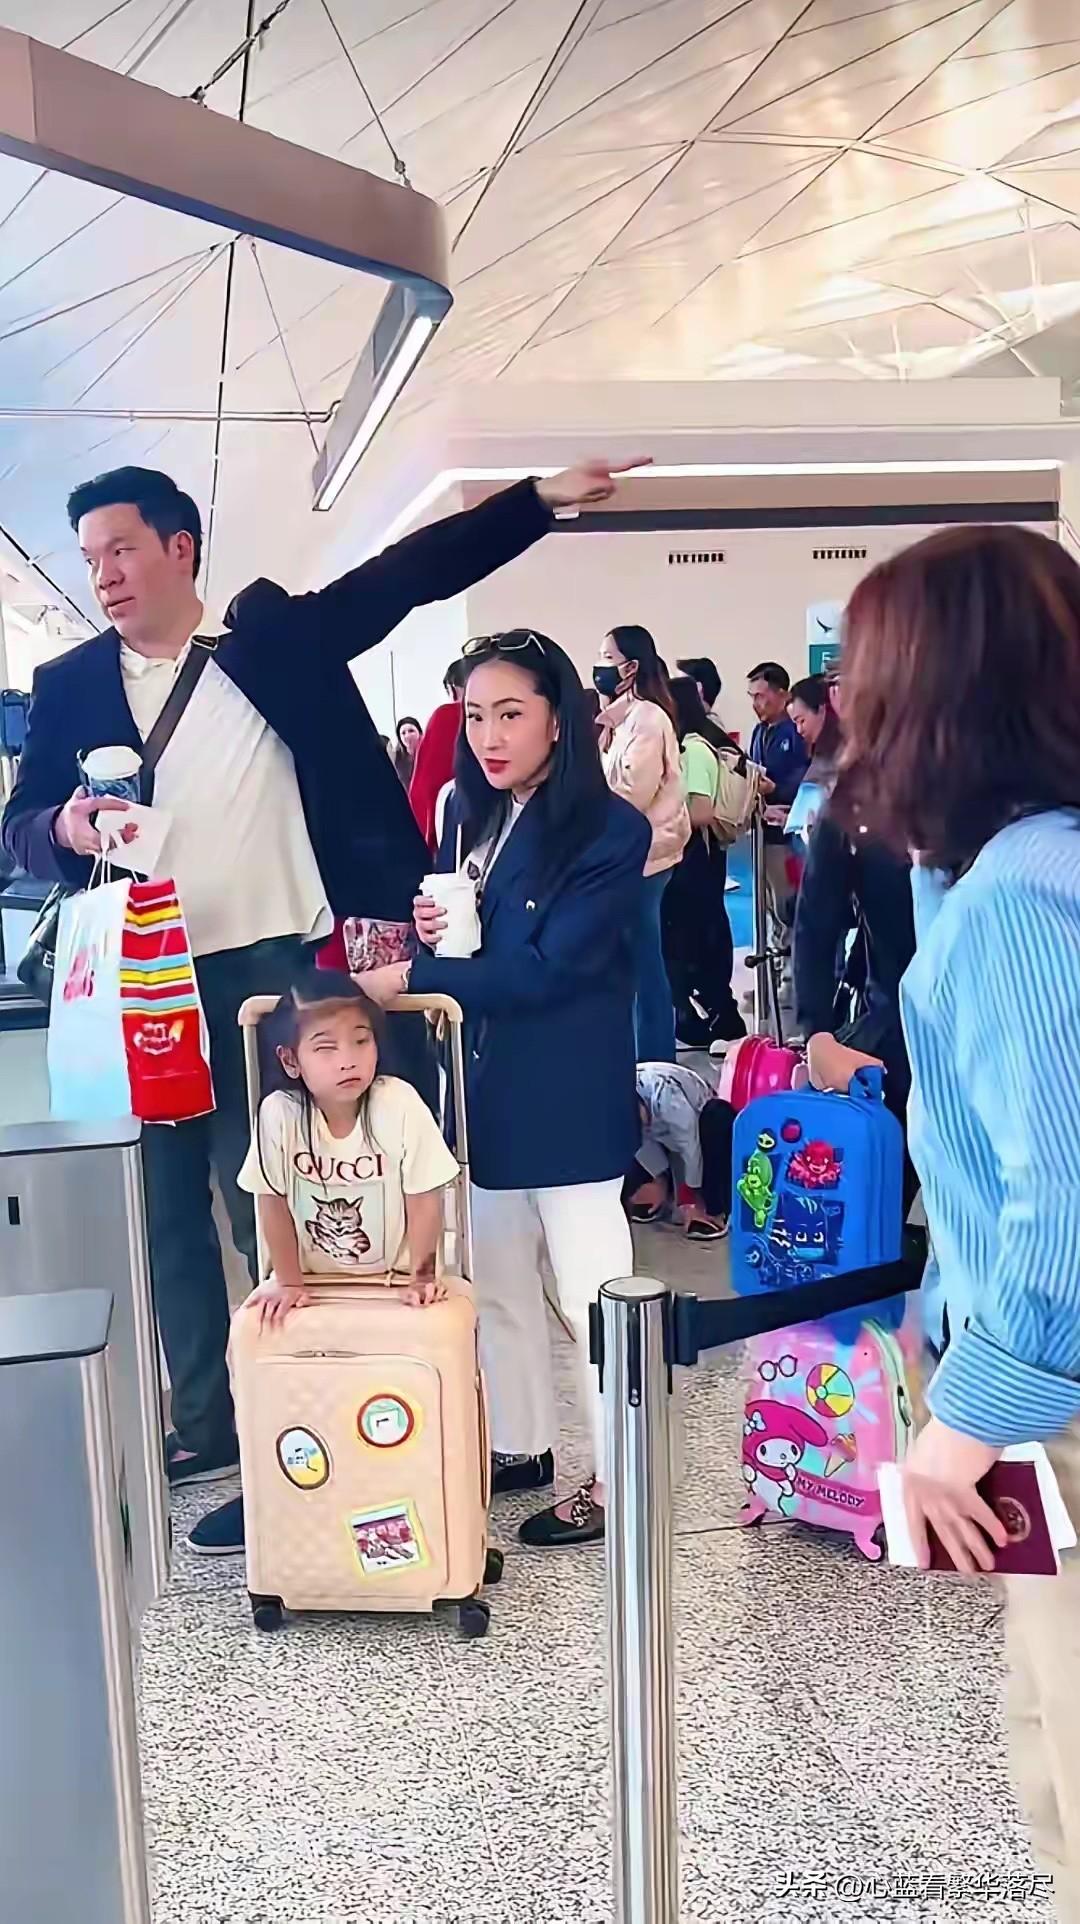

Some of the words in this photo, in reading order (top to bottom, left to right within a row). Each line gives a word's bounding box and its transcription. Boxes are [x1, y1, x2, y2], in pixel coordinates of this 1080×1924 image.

[293, 1151, 383, 1183] GUCCI
[797, 1477, 814, 1490] MY
[817, 1485, 865, 1507] MELODY
